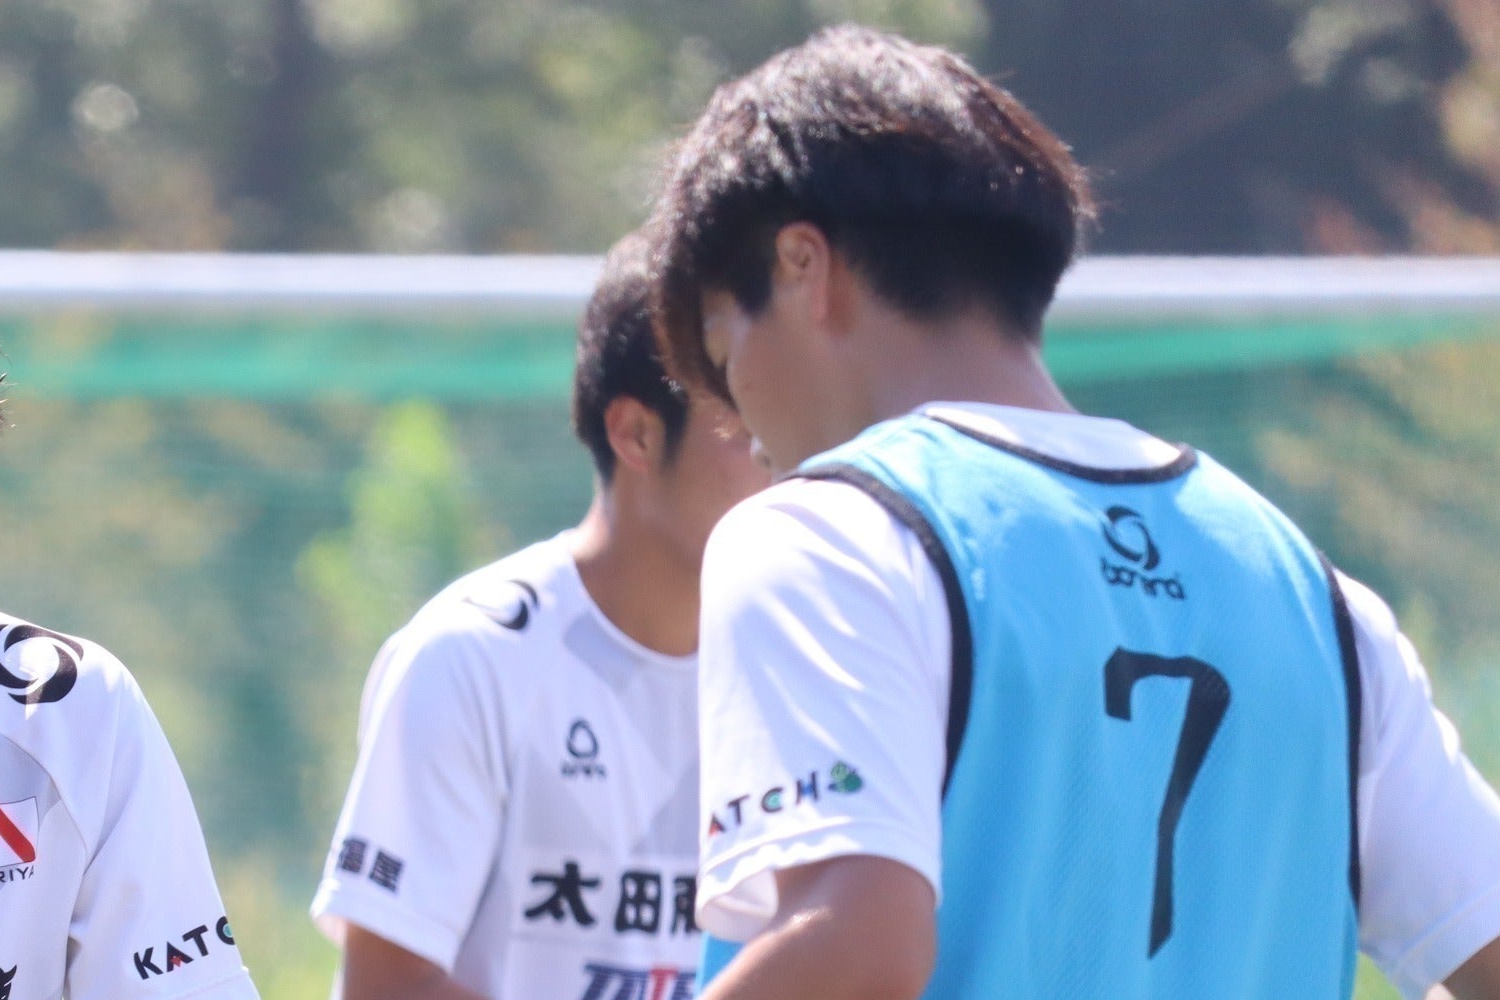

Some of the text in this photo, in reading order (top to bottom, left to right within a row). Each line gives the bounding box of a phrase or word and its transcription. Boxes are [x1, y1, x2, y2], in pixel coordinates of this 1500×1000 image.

[708, 771, 818, 837] ATCH
[1104, 645, 1232, 960] 7
[133, 915, 236, 980] KATC
